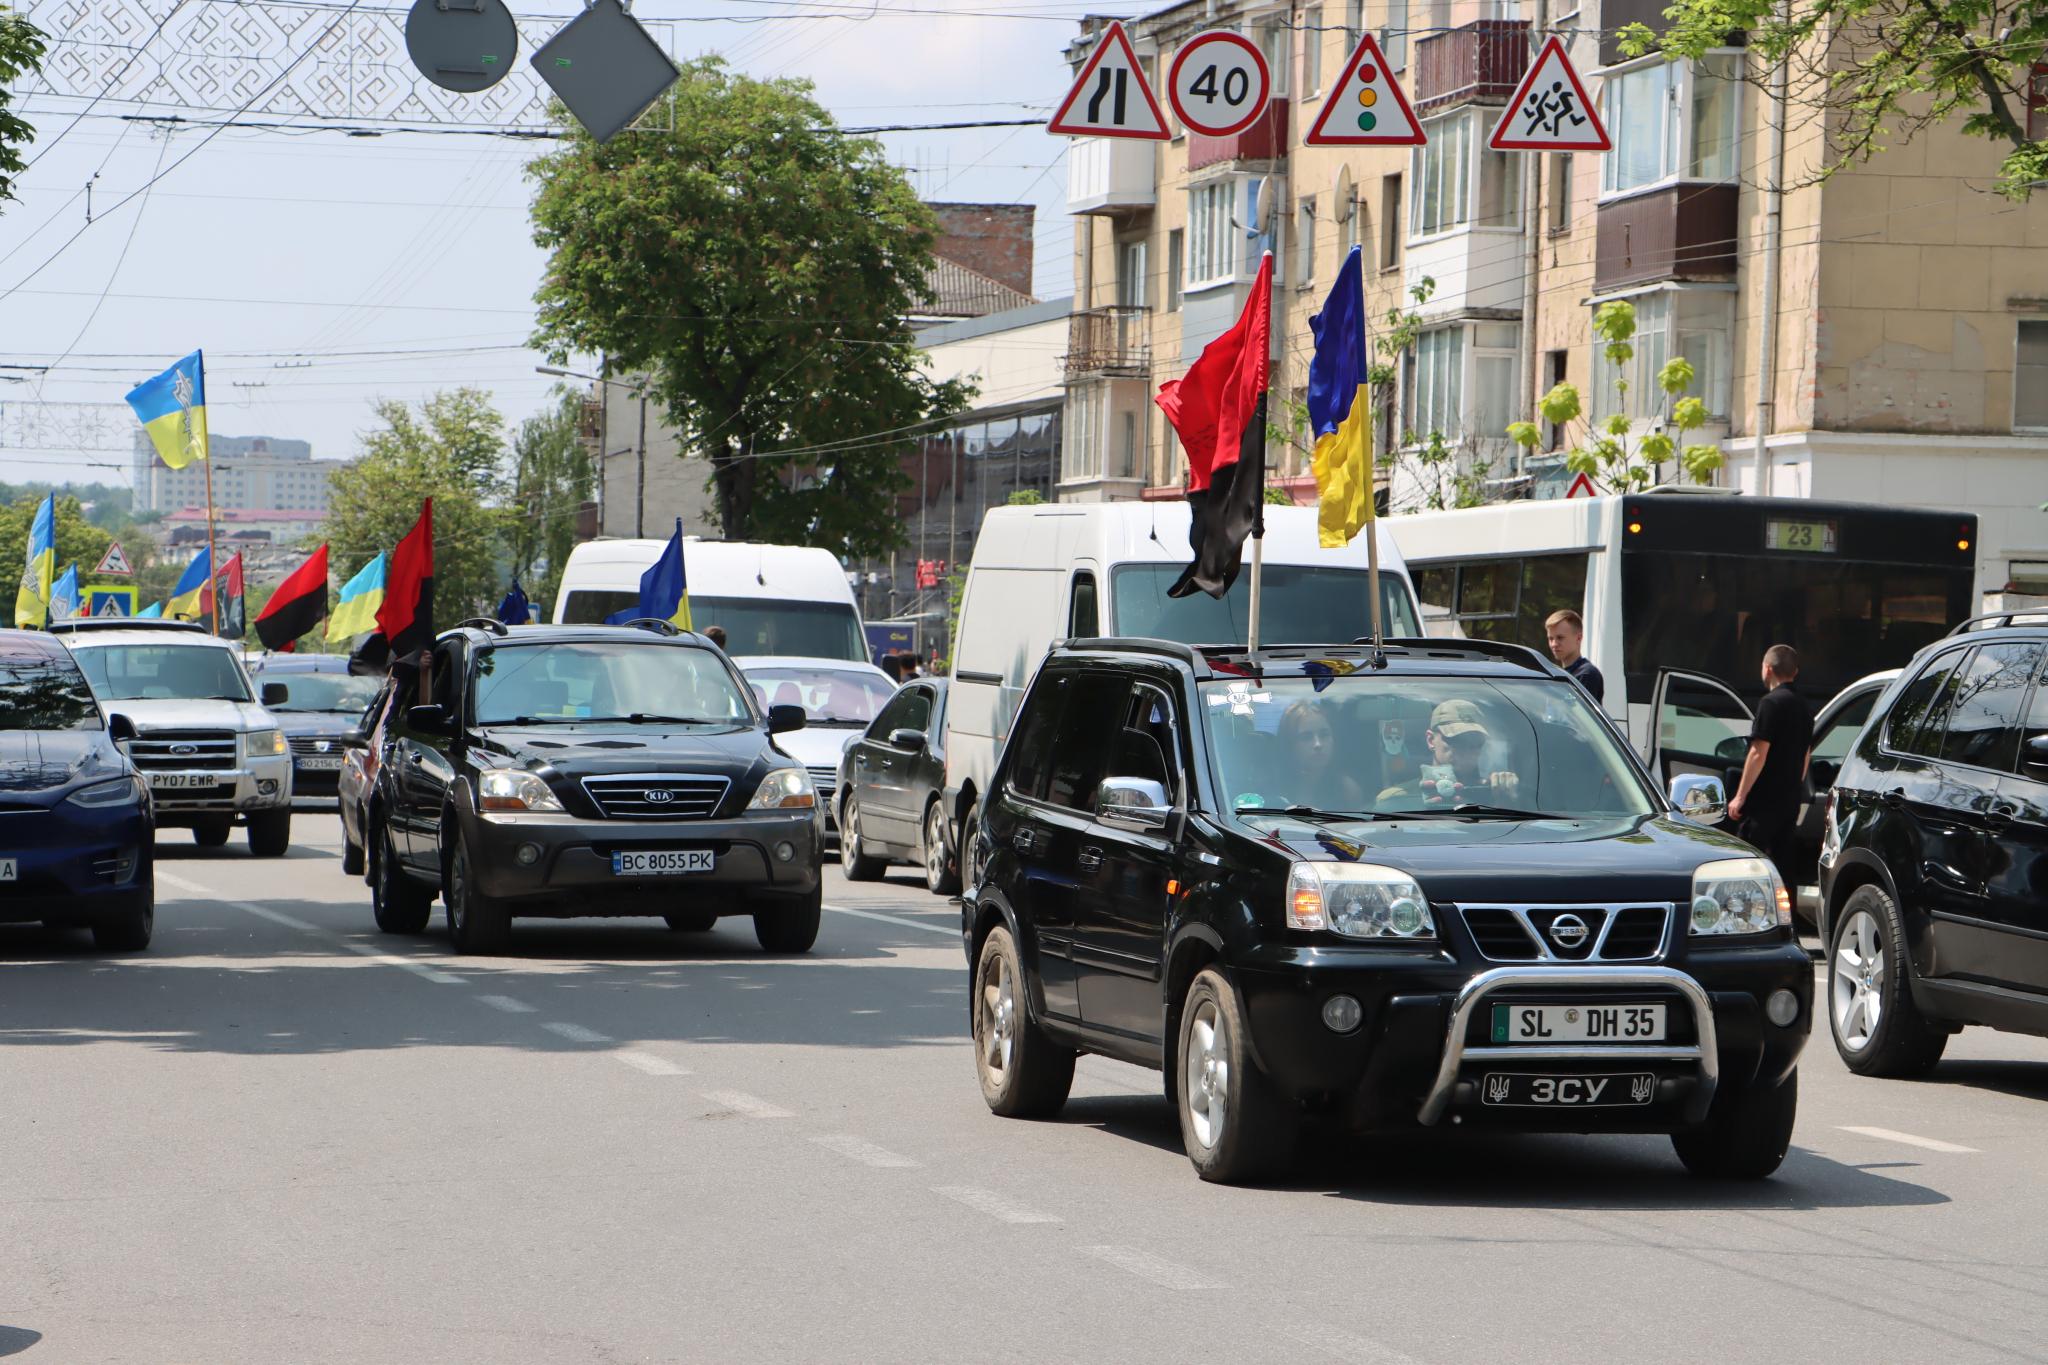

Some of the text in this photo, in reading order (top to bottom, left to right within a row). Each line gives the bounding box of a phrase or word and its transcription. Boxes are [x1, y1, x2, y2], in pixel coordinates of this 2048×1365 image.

[1189, 64, 1249, 106] 40
[1787, 525, 1813, 546] 23
[153, 775, 214, 786] PY07 EWR
[650, 791, 670, 800] KIA
[622, 853, 712, 870] BC 8055 PK
[1520, 1009, 1552, 1037] SL
[1586, 1009, 1618, 1037] DH
[1624, 1008, 1654, 1037] 35
